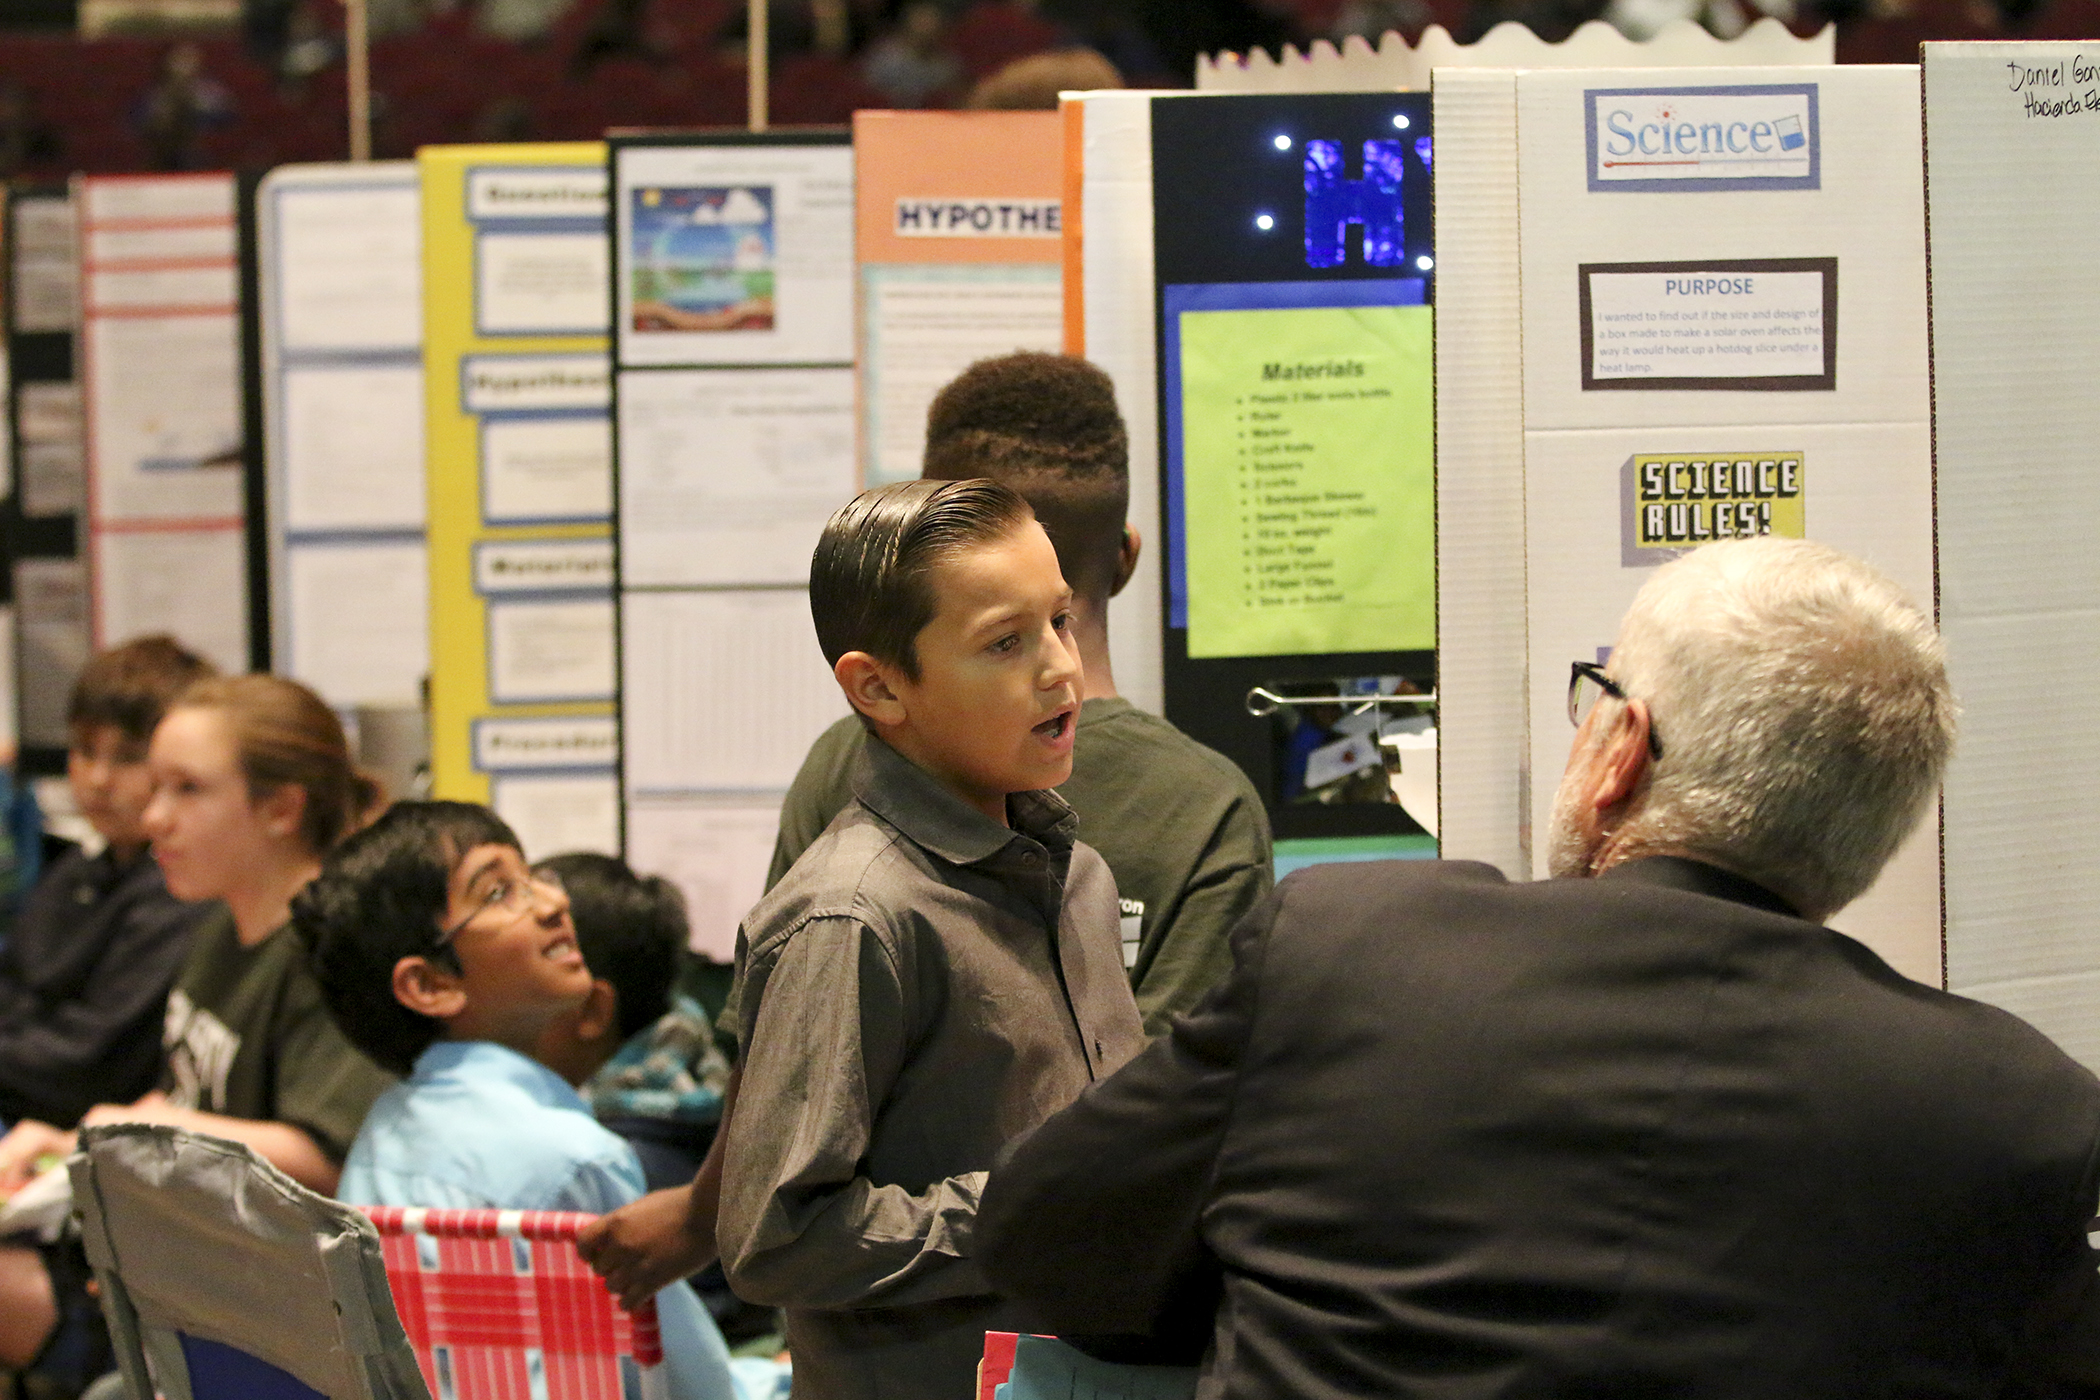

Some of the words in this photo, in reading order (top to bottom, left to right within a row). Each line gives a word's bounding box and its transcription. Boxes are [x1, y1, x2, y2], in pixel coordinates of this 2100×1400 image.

[2006, 60, 2065, 92] Daniel
[1606, 106, 1774, 156] Science
[898, 203, 1062, 231] HYPOTHE
[1665, 278, 1754, 296] PURPOSE
[1604, 311, 1643, 322] wanted
[1645, 312, 1657, 321] to
[1659, 310, 1679, 321] find
[1681, 311, 1699, 321] out
[1701, 310, 1709, 320] if
[1711, 310, 1728, 320] the
[1730, 309, 1750, 320] size
[1752, 309, 1771, 320] and
[1773, 308, 1806, 321] design
[1809, 308, 1820, 318] of
[1599, 331, 1606, 339] a
[1608, 329, 1626, 339] box
[1629, 328, 1658, 339] made
[1660, 329, 1672, 338] to
[1673, 327, 1701, 338] make
[1703, 329, 1711, 337] a
[1713, 327, 1737, 337] solar
[1740, 327, 1766, 337] oven
[1767, 325, 1802, 336] affects
[1804, 325, 1822, 336] the
[1600, 348, 1620, 359] way
[1622, 346, 1630, 356] it
[1632, 345, 1664, 356] would
[1666, 345, 1690, 355] heat
[1692, 346, 1706, 357] up
[1708, 346, 1714, 354] a
[1716, 344, 1753, 356] hotdog
[1755, 343, 1777, 353] slice
[1779, 343, 1810, 353] under
[1812, 344, 1819, 353] a
[1262, 360, 1365, 381] Materials
[1599, 363, 1623, 374] heat
[1625, 362, 1654, 374] lamp.
[1641, 460, 1800, 500] SCIENCE
[1642, 501, 1772, 542] RULES!
